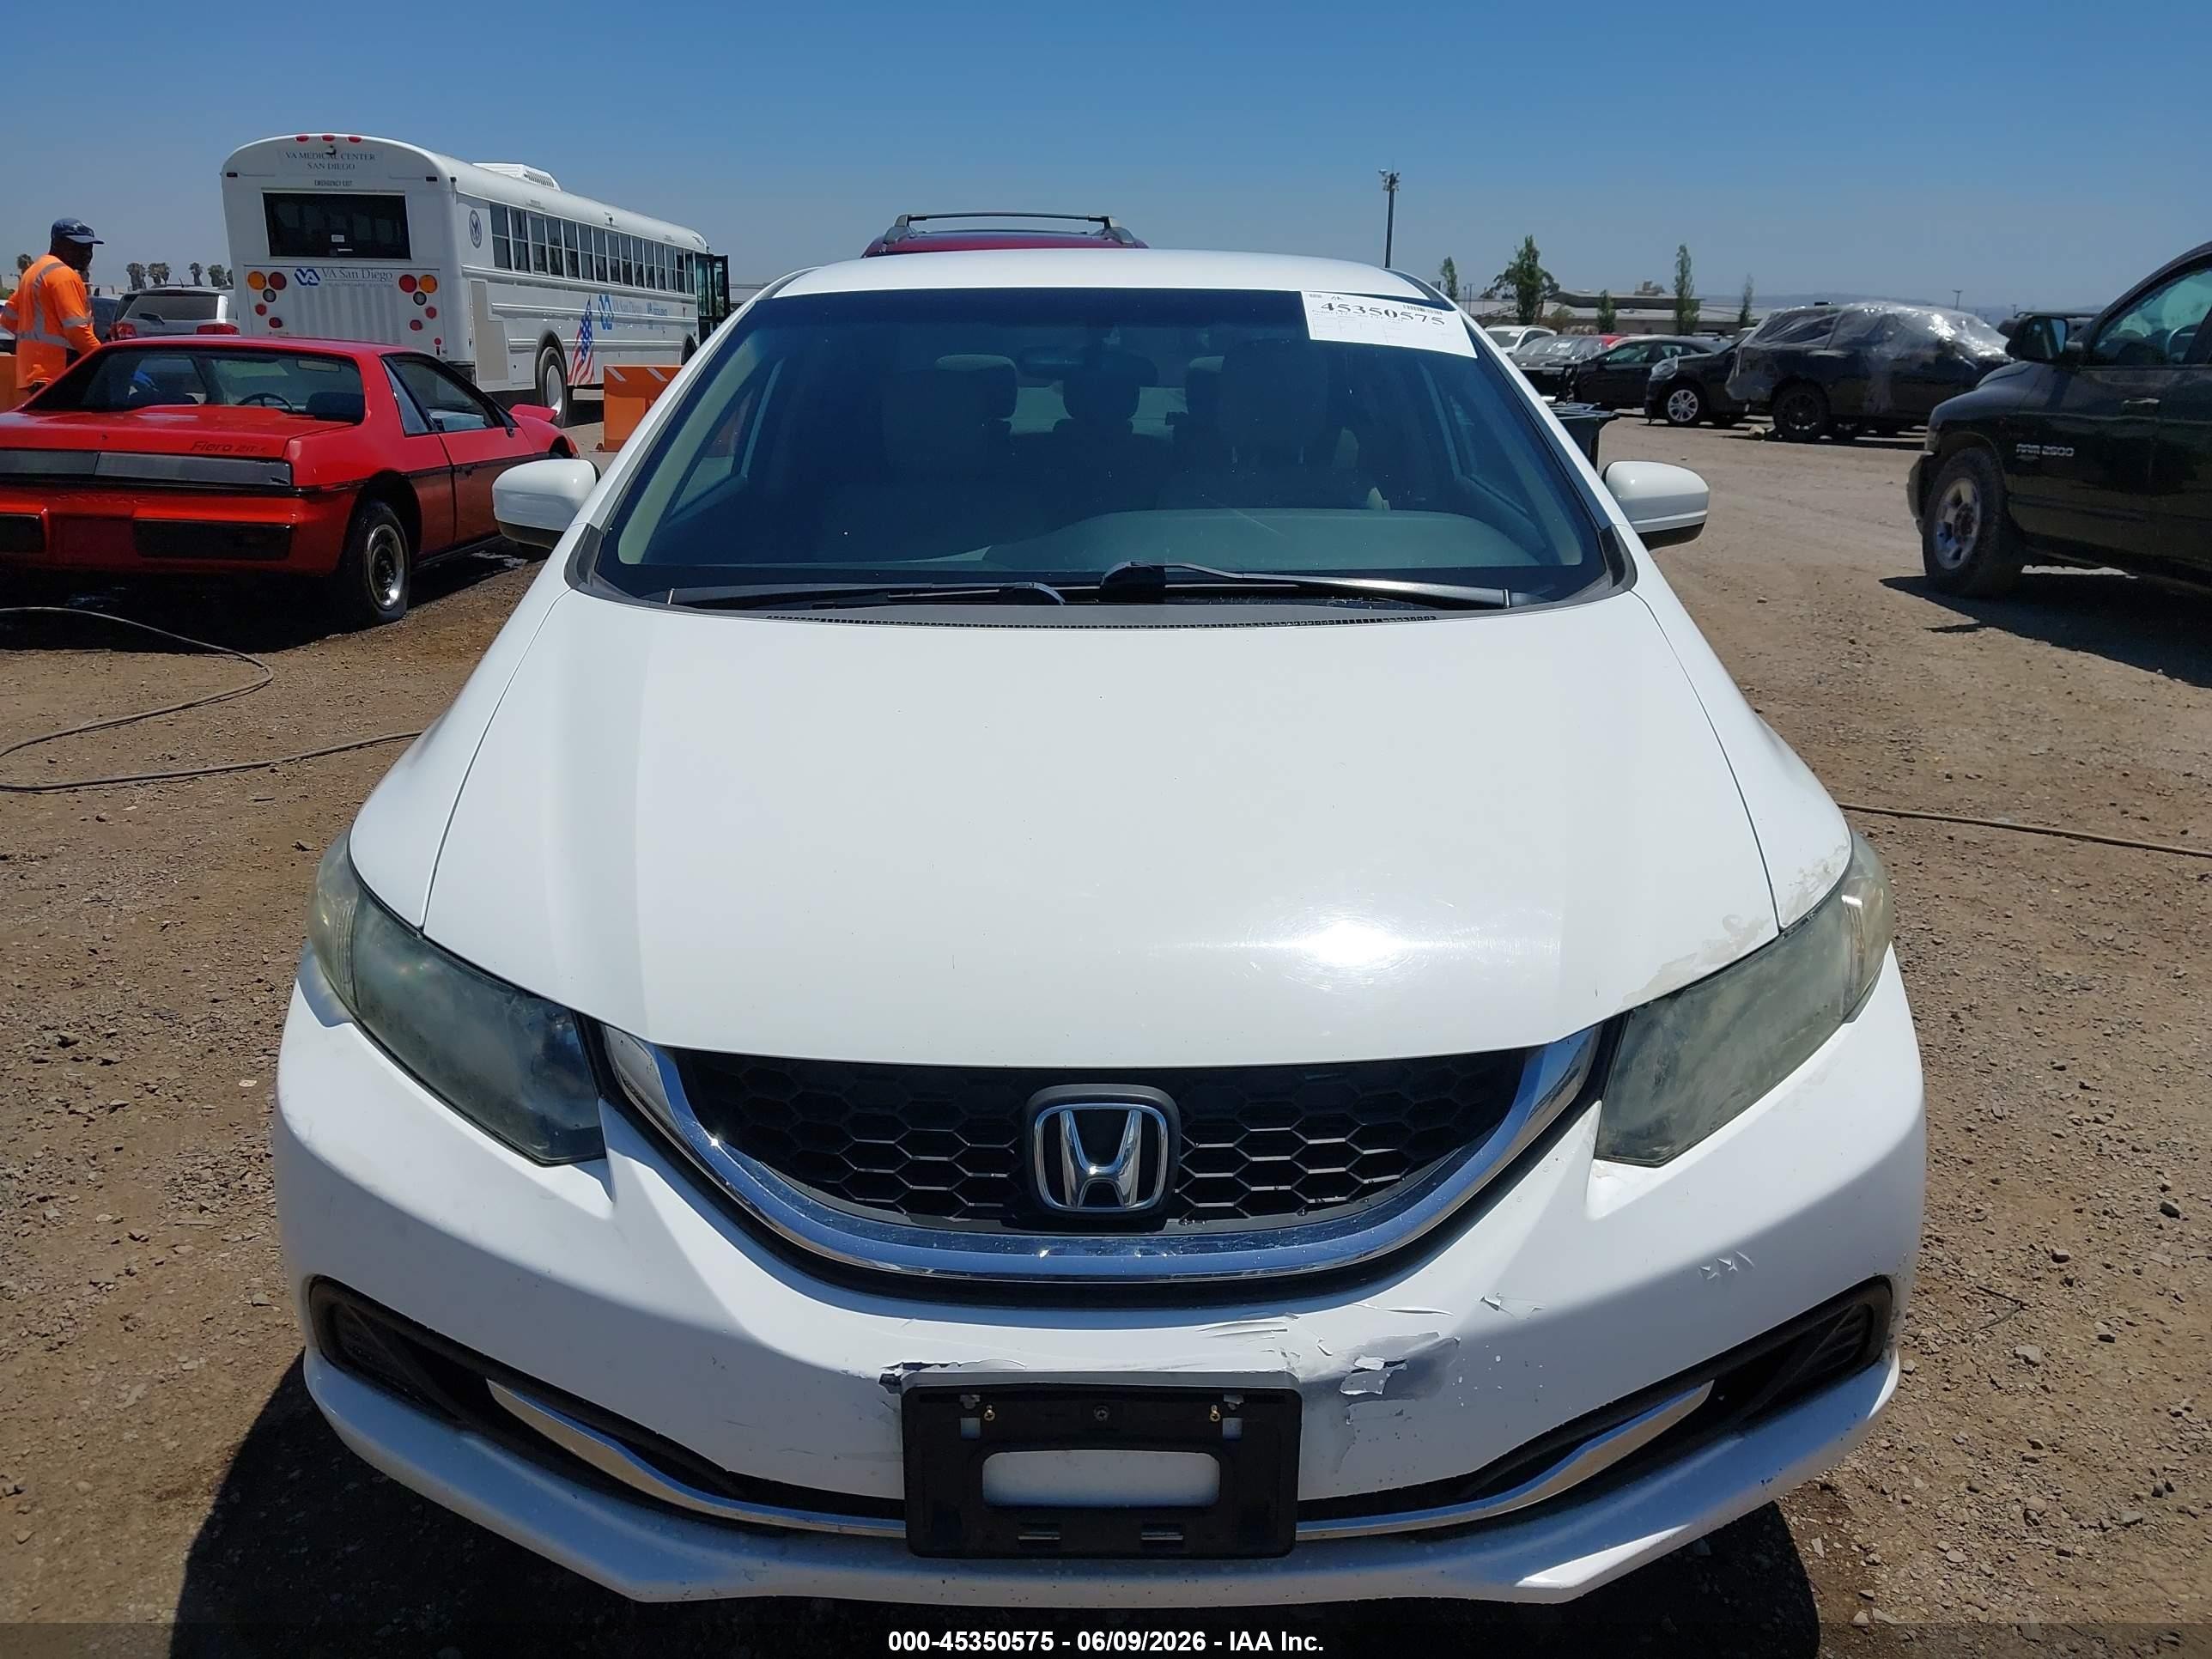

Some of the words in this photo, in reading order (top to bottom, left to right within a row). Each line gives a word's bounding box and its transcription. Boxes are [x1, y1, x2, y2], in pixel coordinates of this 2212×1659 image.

[298, 151, 337, 160] MEDICAL
[340, 152, 376, 161] CENTER
[327, 162, 356, 171] DIEGO
[322, 267, 337, 278] VA
[339, 269, 358, 279] San
[362, 268, 392, 282] Diego
[1321, 302, 1444, 325] 45350575
[190, 441, 234, 452] Fiero
